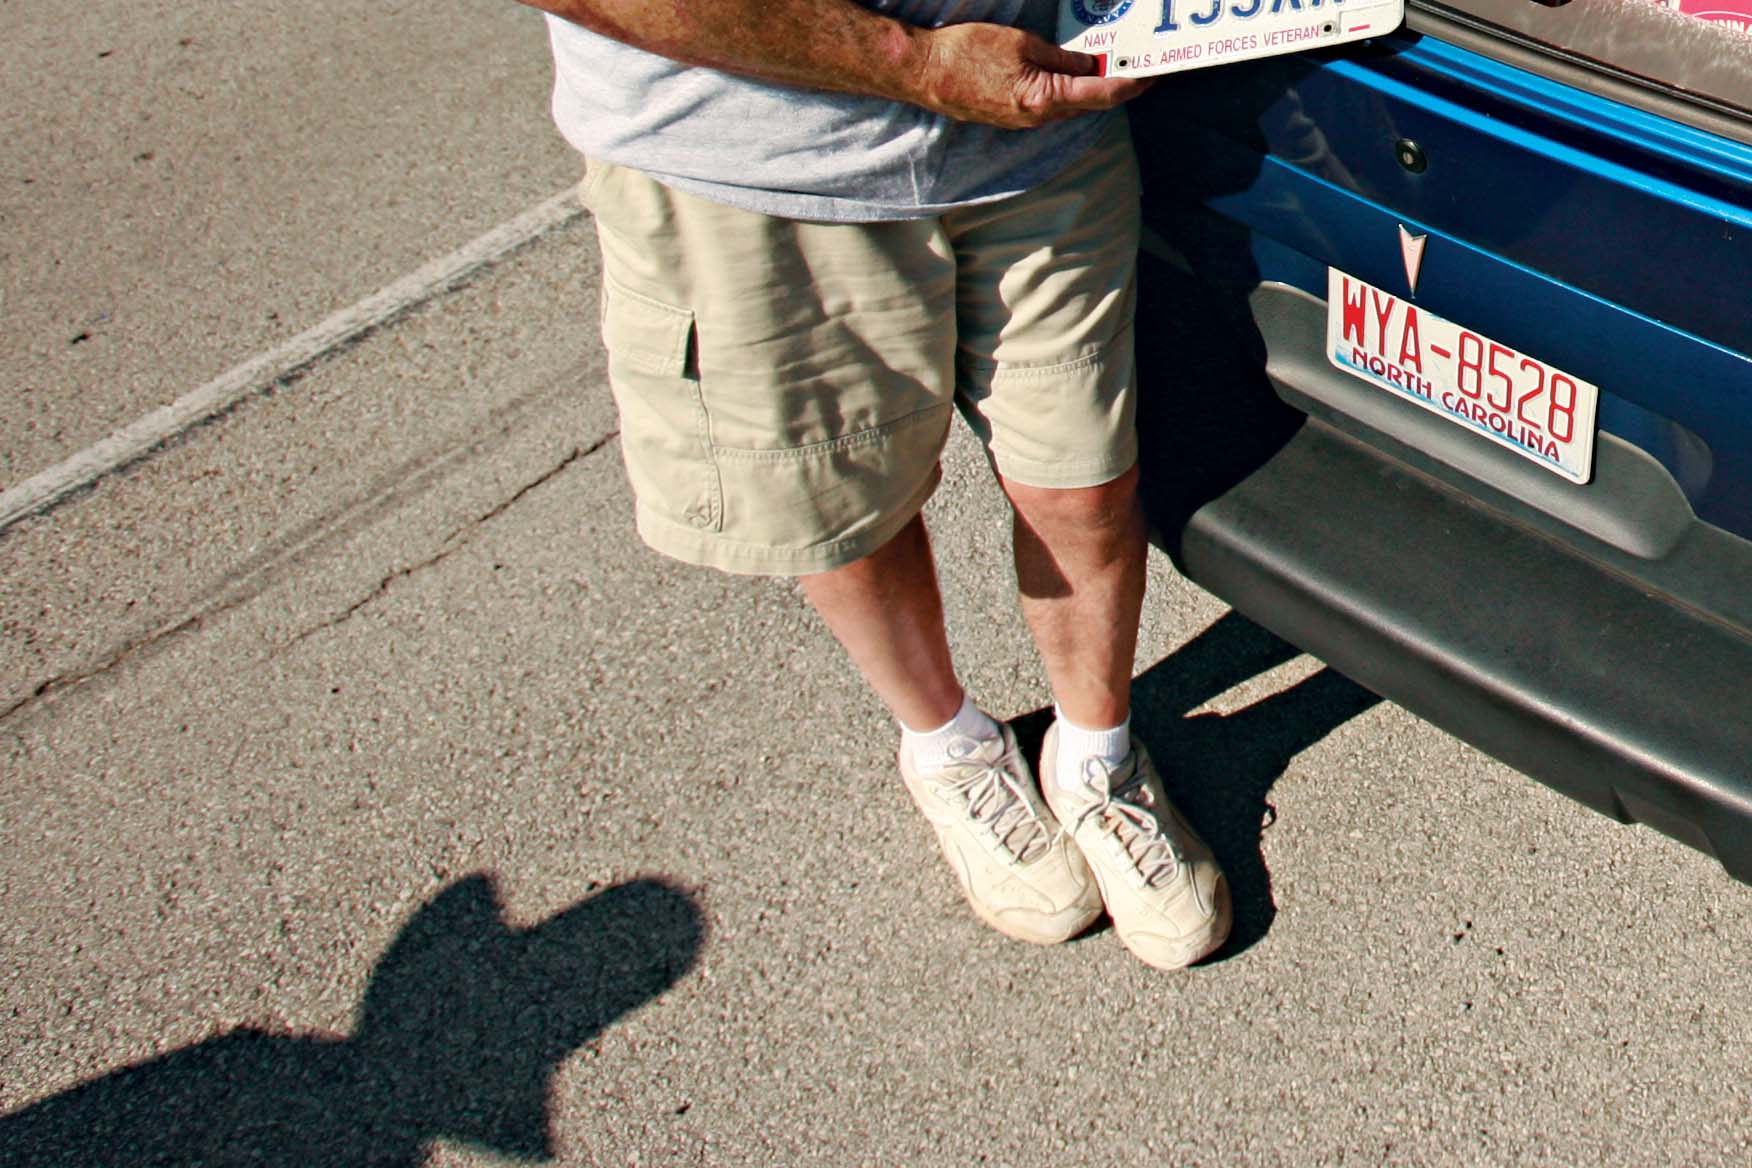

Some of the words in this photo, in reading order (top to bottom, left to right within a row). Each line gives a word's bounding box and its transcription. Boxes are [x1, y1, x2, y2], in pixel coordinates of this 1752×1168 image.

[1084, 32, 1117, 48] NAVY
[1132, 54, 1154, 69] U.S.
[1160, 44, 1201, 65] ARMED
[1208, 35, 1257, 56] FORCES
[1264, 24, 1320, 46] VETERAN
[1343, 276, 1577, 444] WYA-8528
[1352, 346, 1432, 400] NORTH
[1442, 390, 1561, 462] CAROLINA
